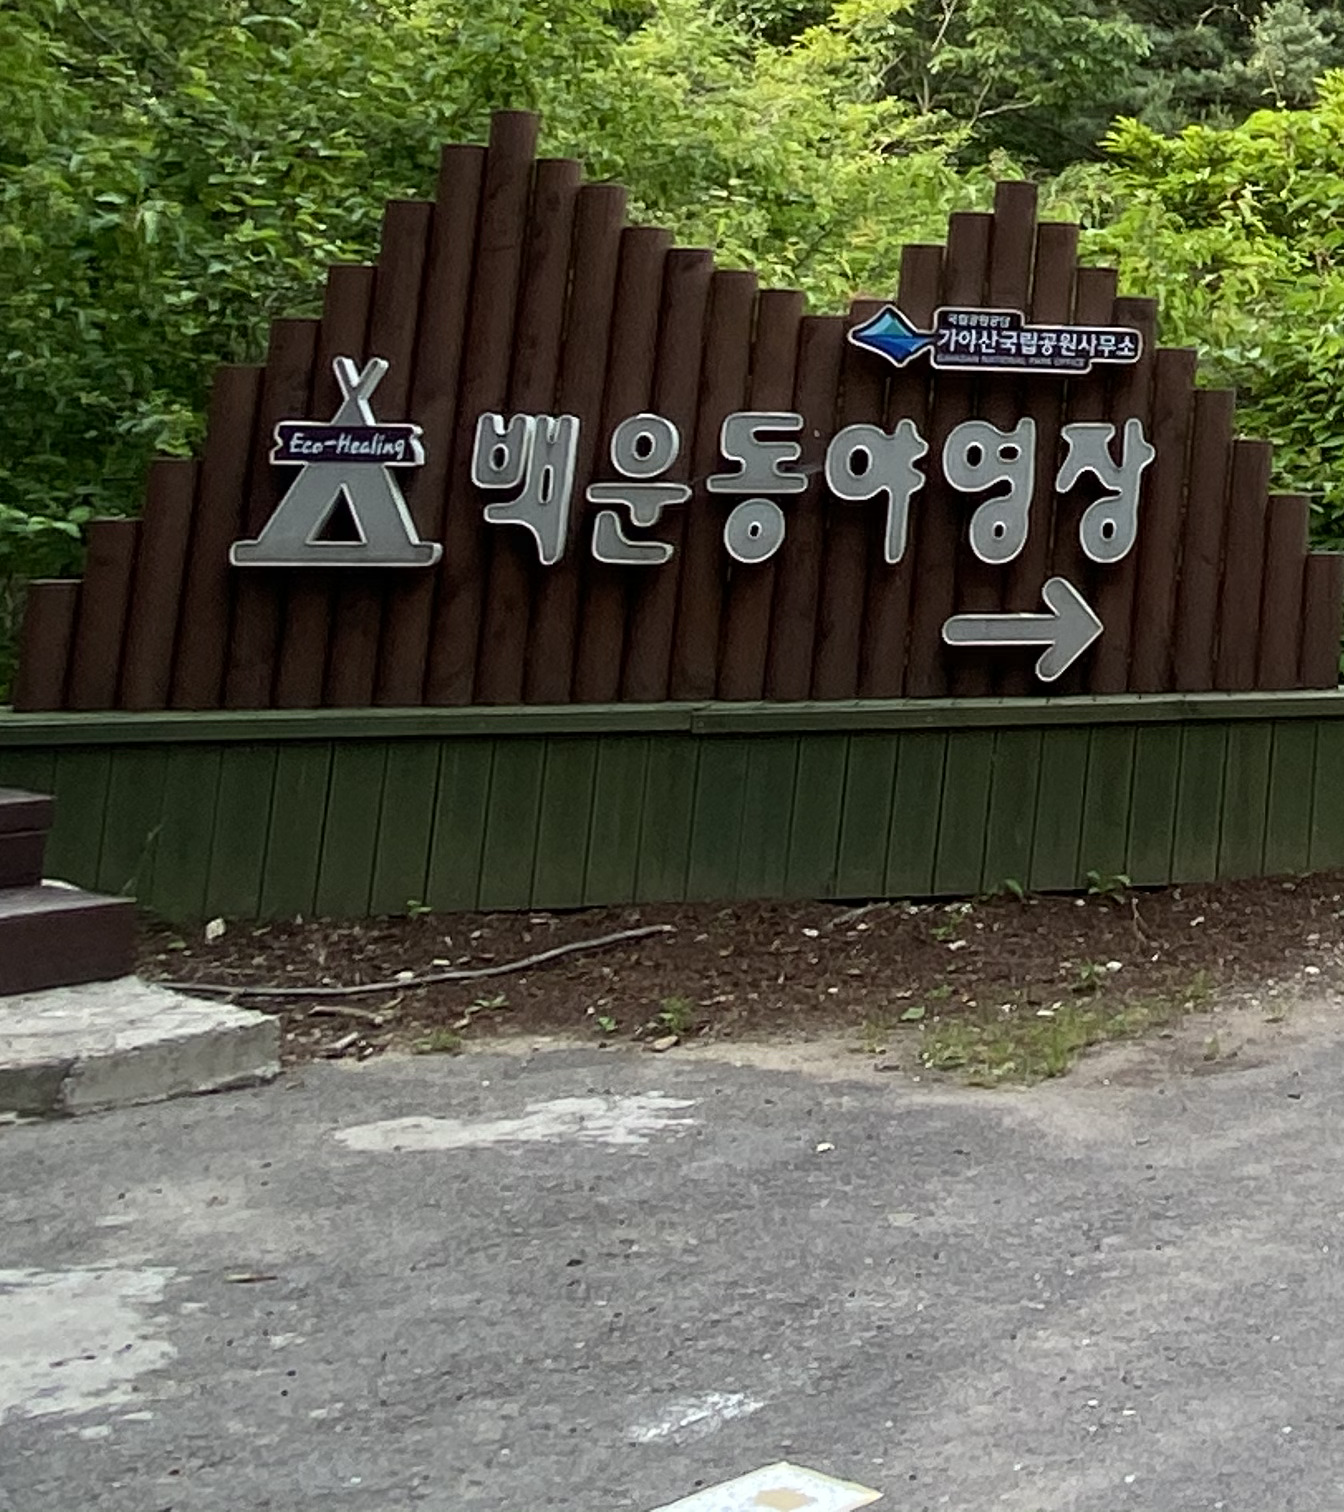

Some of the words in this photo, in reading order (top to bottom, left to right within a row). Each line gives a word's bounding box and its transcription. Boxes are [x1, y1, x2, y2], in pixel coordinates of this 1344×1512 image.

[936, 328, 1137, 357] 가야산국립공원사무소
[289, 432, 405, 460] Eco-Healing
[470, 410, 1156, 566] 백운동야영장
